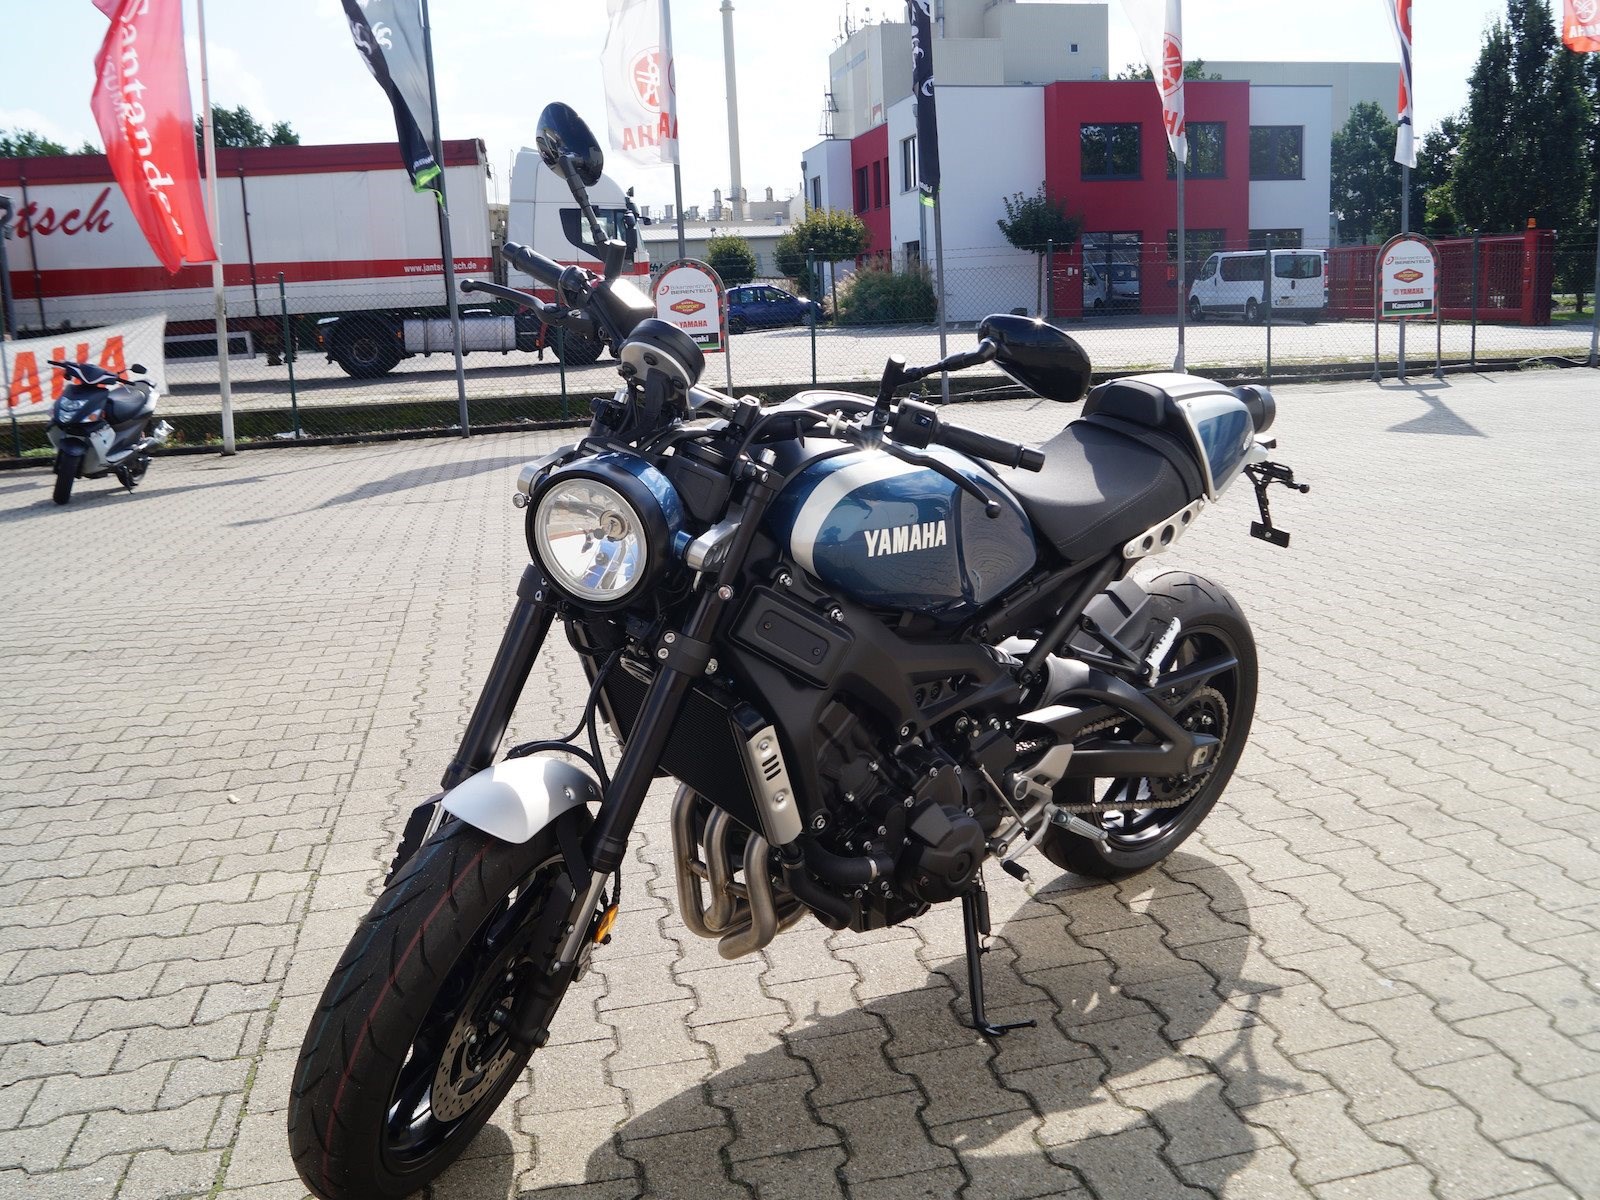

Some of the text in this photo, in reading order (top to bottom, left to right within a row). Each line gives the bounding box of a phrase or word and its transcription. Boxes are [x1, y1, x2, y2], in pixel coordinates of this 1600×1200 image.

[1400, 288, 1424, 296] YAMAHA
[1392, 301, 1425, 309] Kawasaki
[679, 320, 708, 328] YAMAHA
[864, 520, 947, 558] YAMAHA
